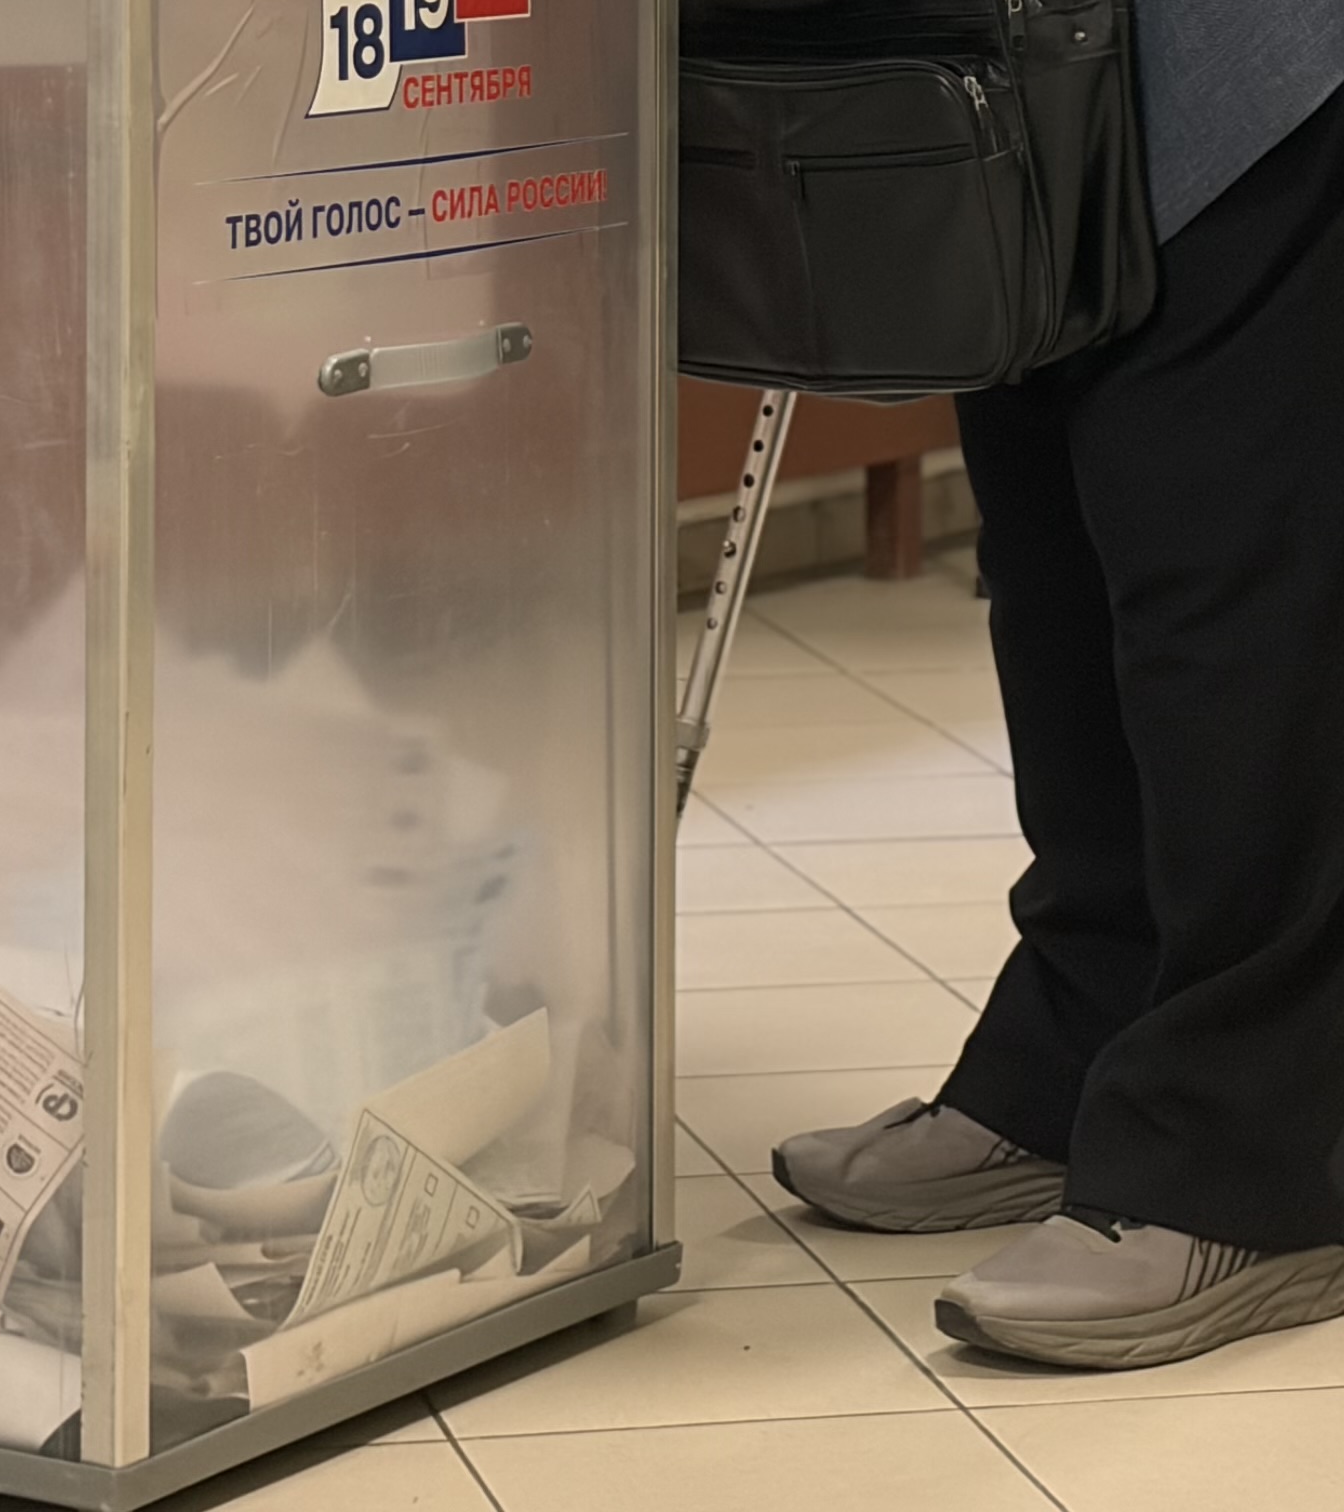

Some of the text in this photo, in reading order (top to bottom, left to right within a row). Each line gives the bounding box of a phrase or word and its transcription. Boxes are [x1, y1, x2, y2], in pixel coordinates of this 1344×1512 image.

[330, 3, 385, 80] 18
[402, 66, 532, 109] СЕНТЯБРЯ
[225, 198, 303, 249] ТВОЙ
[312, 196, 401, 239] ГОЛОС
[432, 184, 500, 222] СИЛА
